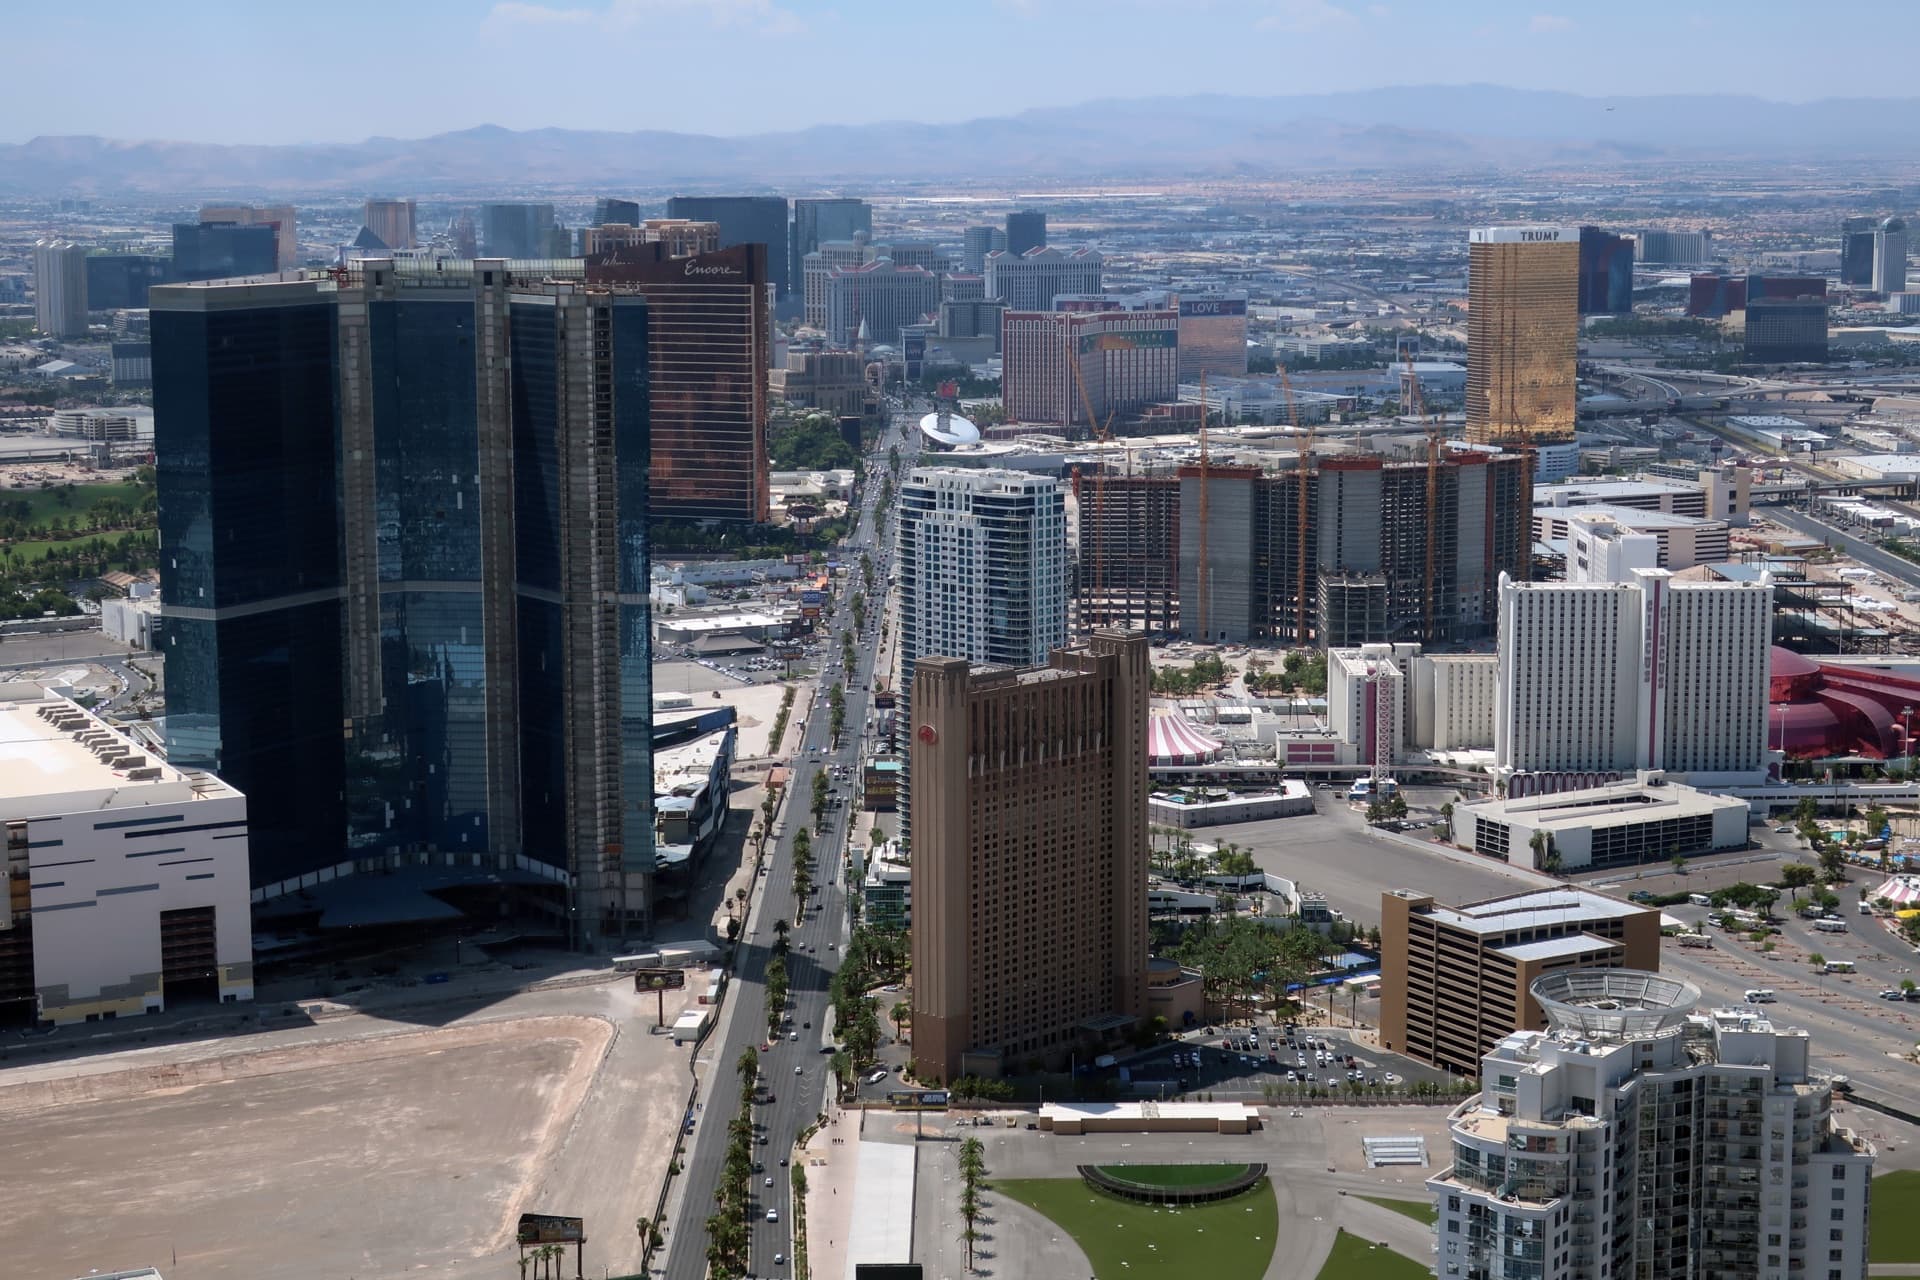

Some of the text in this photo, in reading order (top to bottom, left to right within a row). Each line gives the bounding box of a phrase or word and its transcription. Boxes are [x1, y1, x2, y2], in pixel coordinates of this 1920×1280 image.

[1521, 231, 1560, 241] TRUMP
[684, 259, 742, 276] Encore
[1191, 302, 1220, 314] LOVE
[1644, 600, 1654, 683] CIRCUS
[1658, 606, 1667, 689] CIRCUS
